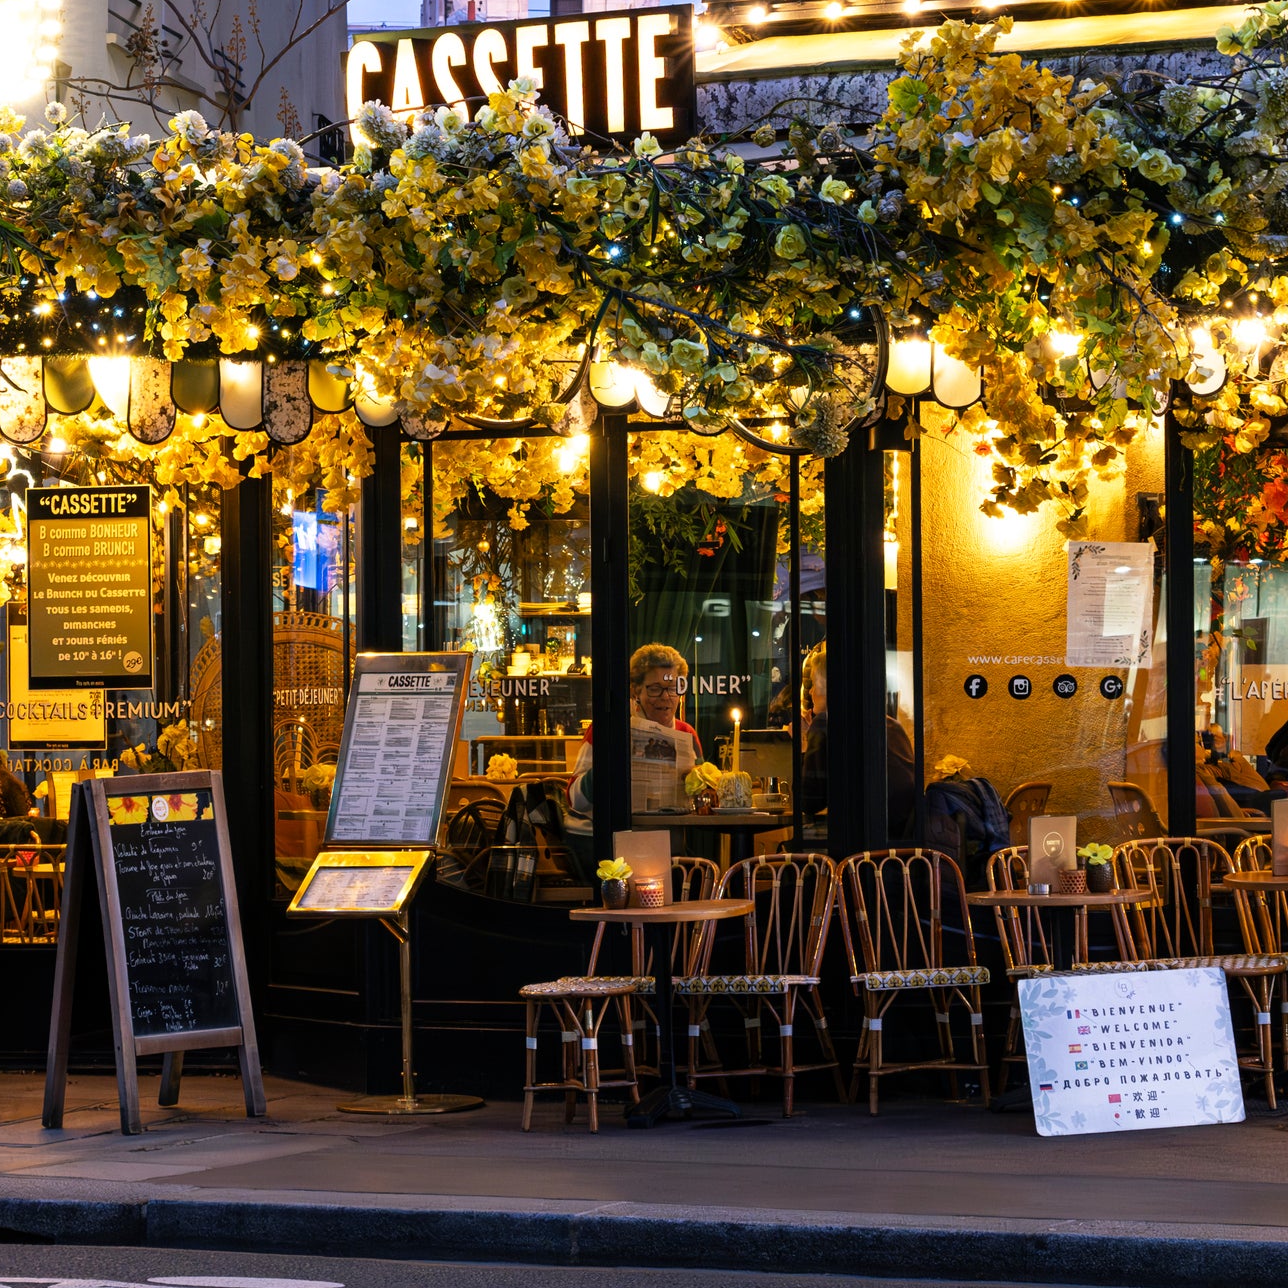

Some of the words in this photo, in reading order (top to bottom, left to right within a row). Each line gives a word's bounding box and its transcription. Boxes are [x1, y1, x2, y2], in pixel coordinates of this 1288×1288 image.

[346, 13, 675, 149] CASSETTE
[39, 526, 46, 540] B
[49, 527, 87, 540] comme
[90, 523, 138, 539] BONHEUR
[43, 543, 50, 557] B
[53, 544, 91, 557] comme
[94, 541, 135, 556] BRUNCH
[126, 656, 143, 669] 29€
[388, 675, 431, 688] CASSETTE
